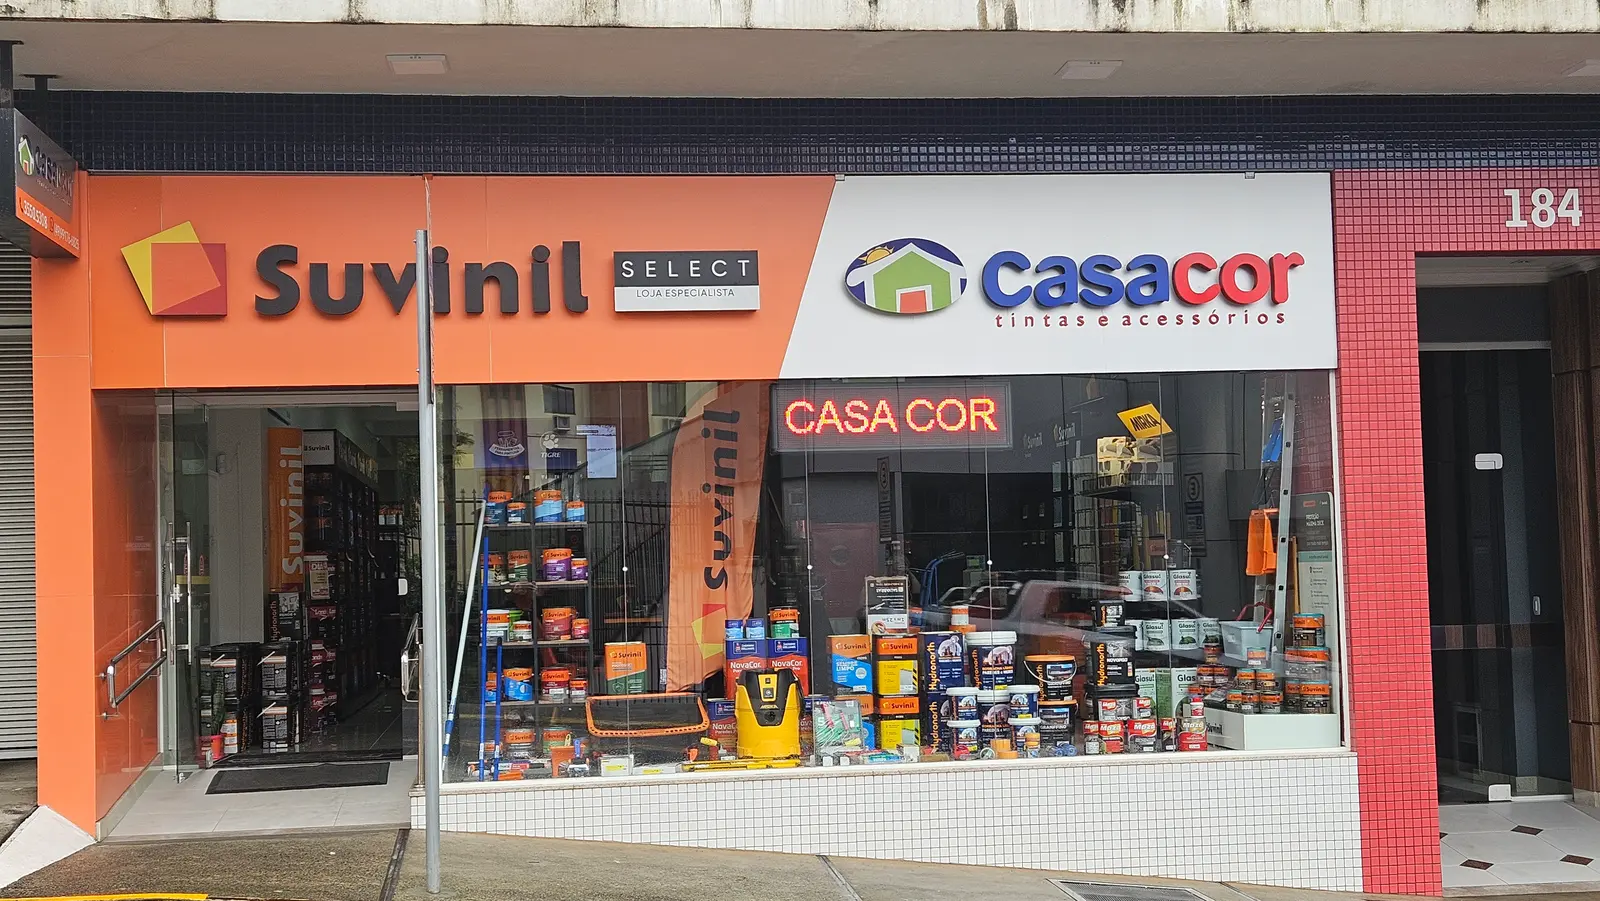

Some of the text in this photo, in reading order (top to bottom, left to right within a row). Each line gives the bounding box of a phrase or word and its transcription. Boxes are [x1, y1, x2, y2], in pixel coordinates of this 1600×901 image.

[1503, 188, 1582, 227] 184
[255, 241, 588, 315] Suvinil
[621, 260, 749, 278] SELECT
[636, 288, 735, 297] LOJA ESPECIALISTA
[995, 308, 1286, 328] tintas e acessórios
[784, 398, 998, 435] CASA COR
[1130, 413, 1161, 431] MIRKA
[280, 446, 303, 575] Suvinil
[701, 409, 740, 592] Suvinil
[927, 642, 940, 690] Hydronorth
[1096, 643, 1108, 686] Hydronorth
[712, 722, 736, 730] NovaC
[929, 701, 942, 749] Hydronorth
